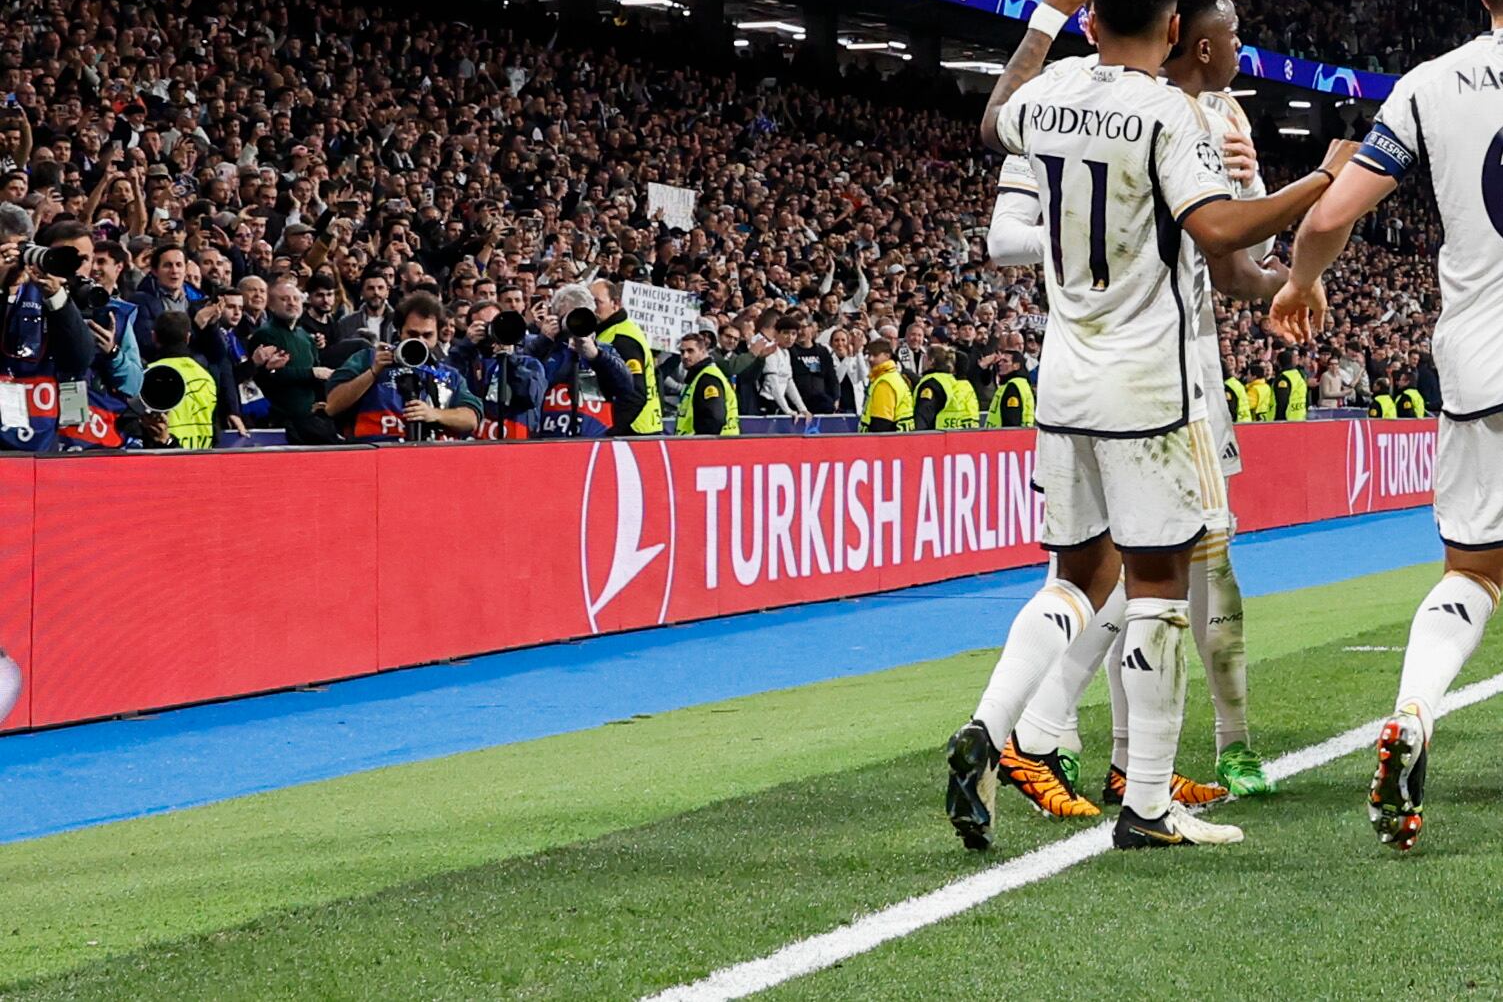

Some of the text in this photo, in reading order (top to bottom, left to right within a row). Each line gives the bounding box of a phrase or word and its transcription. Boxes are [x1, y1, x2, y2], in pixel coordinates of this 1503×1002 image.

[1031, 104, 1143, 143] RODRYGO
[1034, 153, 1110, 291] 11
[696, 450, 1048, 589] TURKISH AIRLINE
